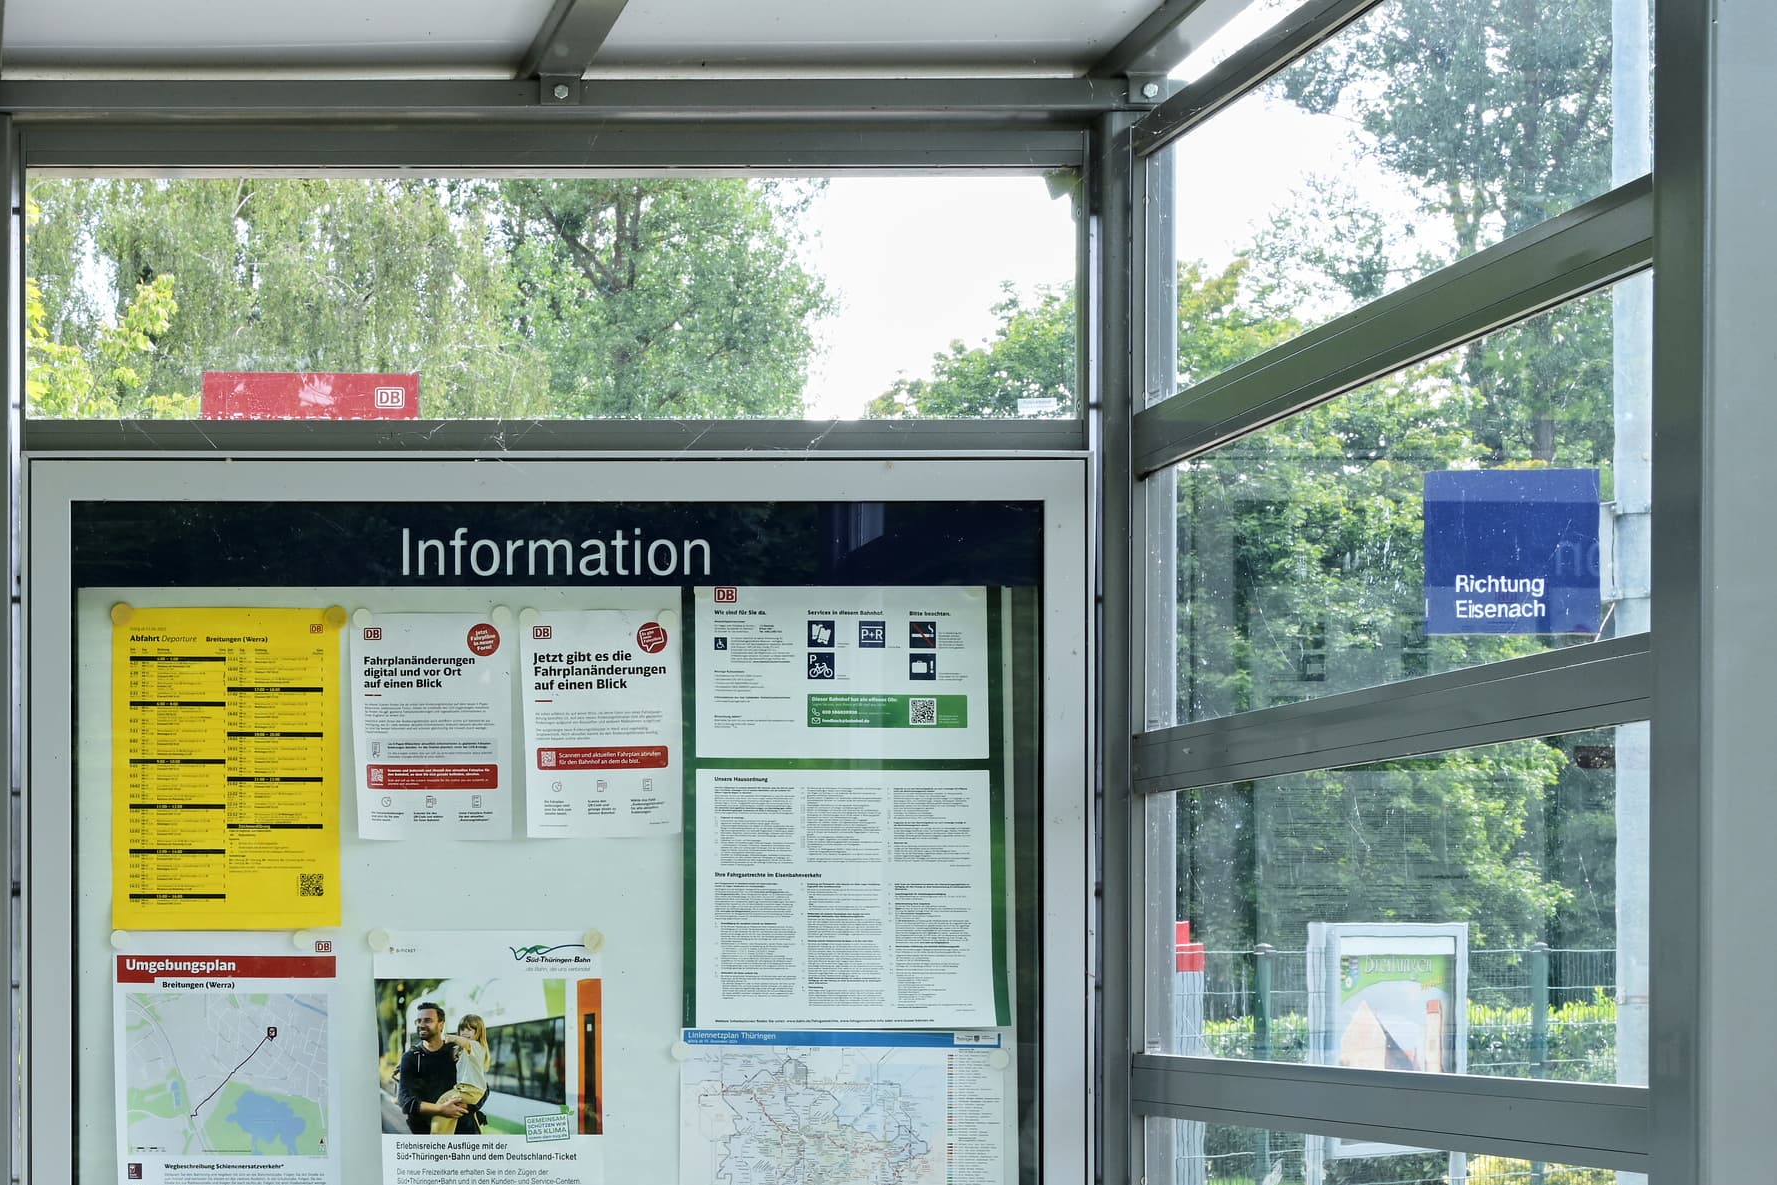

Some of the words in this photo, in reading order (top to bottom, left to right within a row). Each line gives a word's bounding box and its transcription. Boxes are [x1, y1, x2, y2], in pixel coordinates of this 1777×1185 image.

[376, 389, 403, 407] DB
[402, 527, 711, 577] Information
[1455, 574, 1545, 597] Richtung
[716, 588, 735, 601] DB
[1456, 600, 1546, 618] Eisenach
[311, 625, 322, 633] DB
[365, 629, 380, 639] DB
[534, 627, 550, 638] DB
[861, 629, 883, 640] P+R
[161, 635, 197, 644] Departure
[364, 656, 475, 667] Fahrplanänderungen
[533, 653, 563, 666] Jetzt
[566, 651, 592, 664] gibt
[612, 650, 632, 661] die
[810, 655, 817, 664] P
[364, 668, 397, 678] digital
[400, 668, 420, 676] und
[443, 667, 462, 676] Ort
[534, 665, 666, 678] Fahrplanänderungen
[364, 679, 380, 688] auf
[384, 679, 413, 688] einen
[416, 679, 442, 688] Blick
[534, 680, 554, 690] auf
[558, 679, 593, 690] einen
[596, 678, 628, 689] Blick
[316, 942, 330, 951] DB
[125, 958, 236, 973] Umgebungsplan
[162, 981, 204, 989] Breitungen
[205, 981, 235, 989] (Werra)
[688, 1032, 739, 1041] Liniennetzplan
[741, 1032, 776, 1042] Thüringen
[396, 1142, 446, 1150] Erlebnisreiche
[447, 1142, 480, 1151] Ausflüge
[482, 1142, 493, 1150] mit
[495, 1142, 508, 1150] der
[506, 1152, 577, 1160] Deutschland-Ticket
[517, 1168, 537, 1177] Zügen
